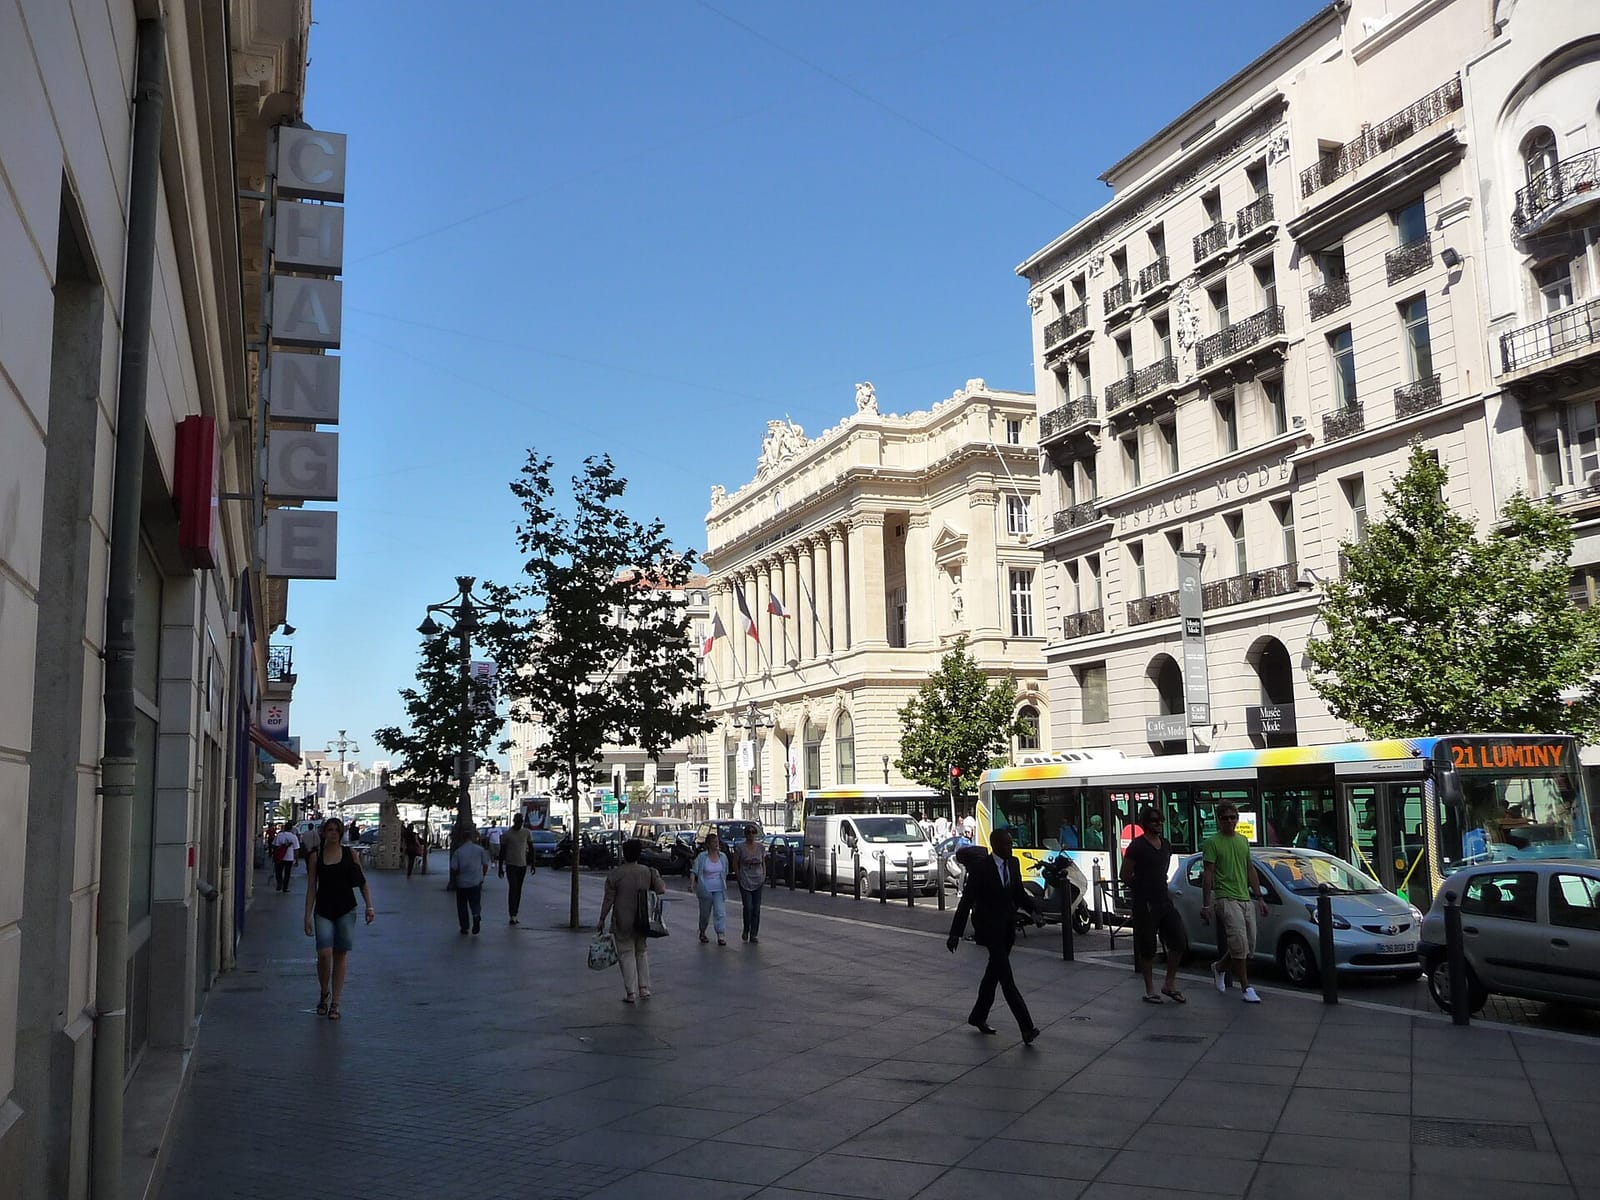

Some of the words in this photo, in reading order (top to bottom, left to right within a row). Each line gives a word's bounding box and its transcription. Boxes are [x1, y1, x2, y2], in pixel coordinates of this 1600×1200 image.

[279, 136, 335, 570] CHANGE
[1119, 488, 1198, 531] ESPACE
[1216, 457, 1289, 501] MODE
[1260, 706, 1281, 718] Musée
[1262, 720, 1280, 732] Mode
[1452, 745, 1477, 768] 21
[1480, 745, 1563, 768] LUMINY
